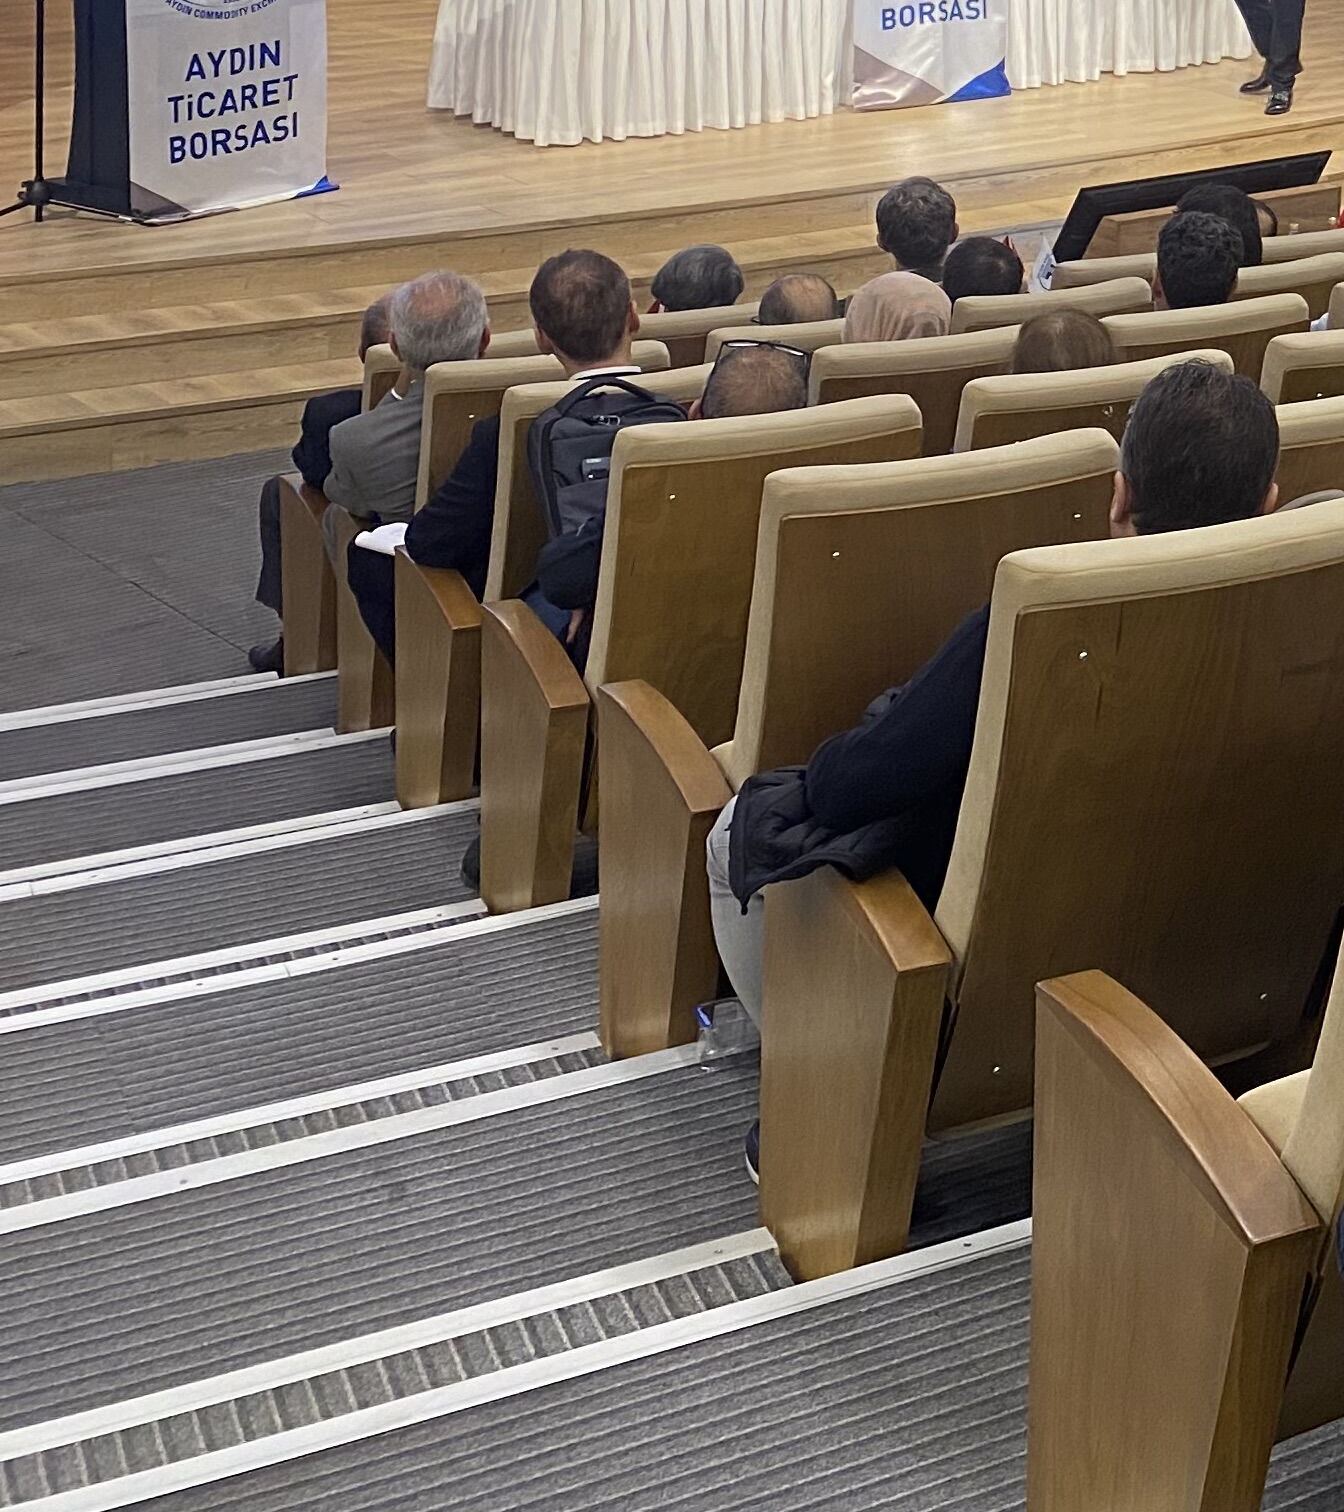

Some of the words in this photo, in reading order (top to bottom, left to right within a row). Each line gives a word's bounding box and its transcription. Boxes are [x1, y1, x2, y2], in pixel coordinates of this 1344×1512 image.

[194, 7, 249, 20] COMMODITY
[185, 40, 281, 82] AYDIN
[170, 112, 298, 164] BORSASI
